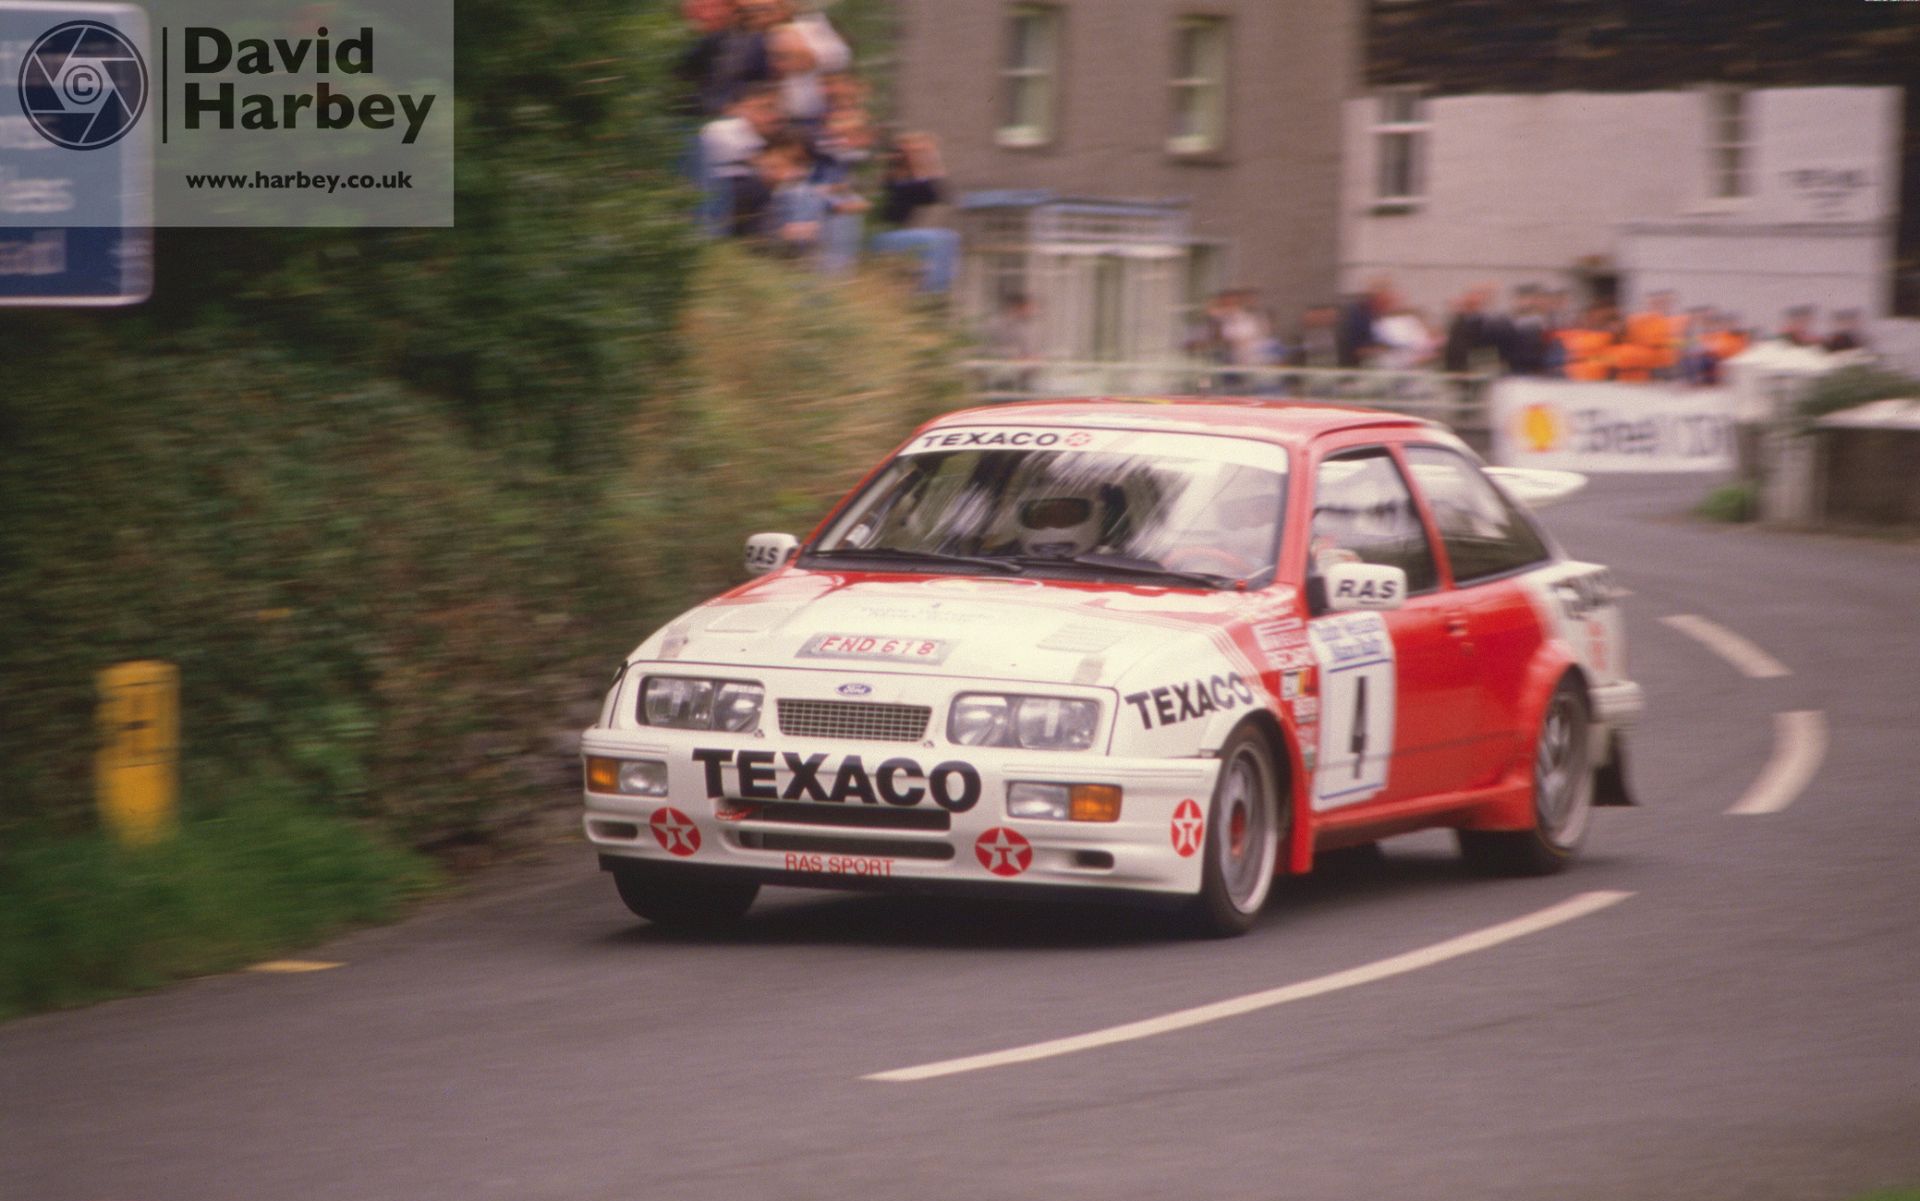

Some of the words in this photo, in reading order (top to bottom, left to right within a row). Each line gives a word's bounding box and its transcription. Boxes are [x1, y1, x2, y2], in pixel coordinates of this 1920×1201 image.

[923, 432, 1059, 449] TEXACO
[1336, 578, 1397, 600] RAS
[881, 640, 935, 656] 618
[1124, 672, 1254, 729] TEXACO
[1350, 676, 1367, 780] 4
[692, 748, 982, 814] TEXACO
[785, 852, 823, 875] RAS
[828, 856, 895, 878] SPORT
